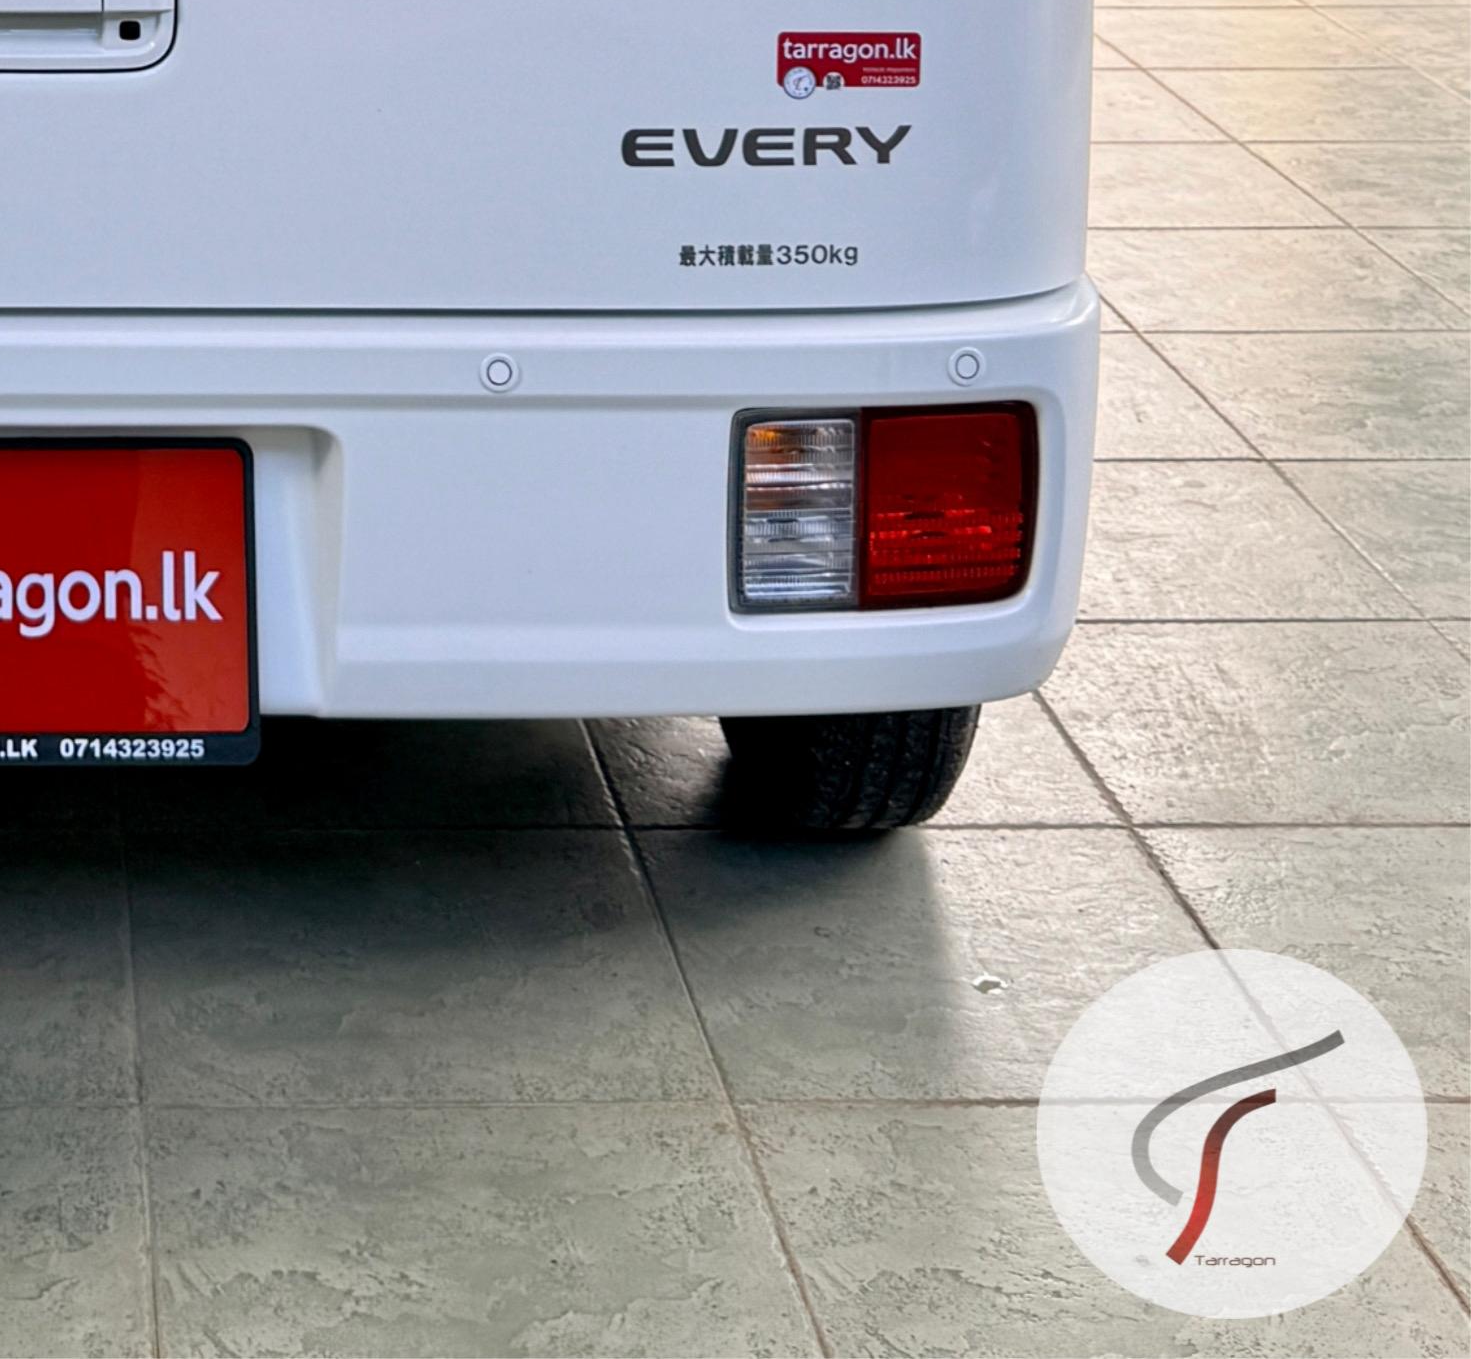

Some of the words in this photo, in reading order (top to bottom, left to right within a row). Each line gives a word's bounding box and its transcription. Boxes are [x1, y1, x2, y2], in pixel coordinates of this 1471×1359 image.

[782, 37, 917, 64] tarragon.lk
[621, 125, 912, 167] EVERY
[59, 737, 205, 759] 0714323925
